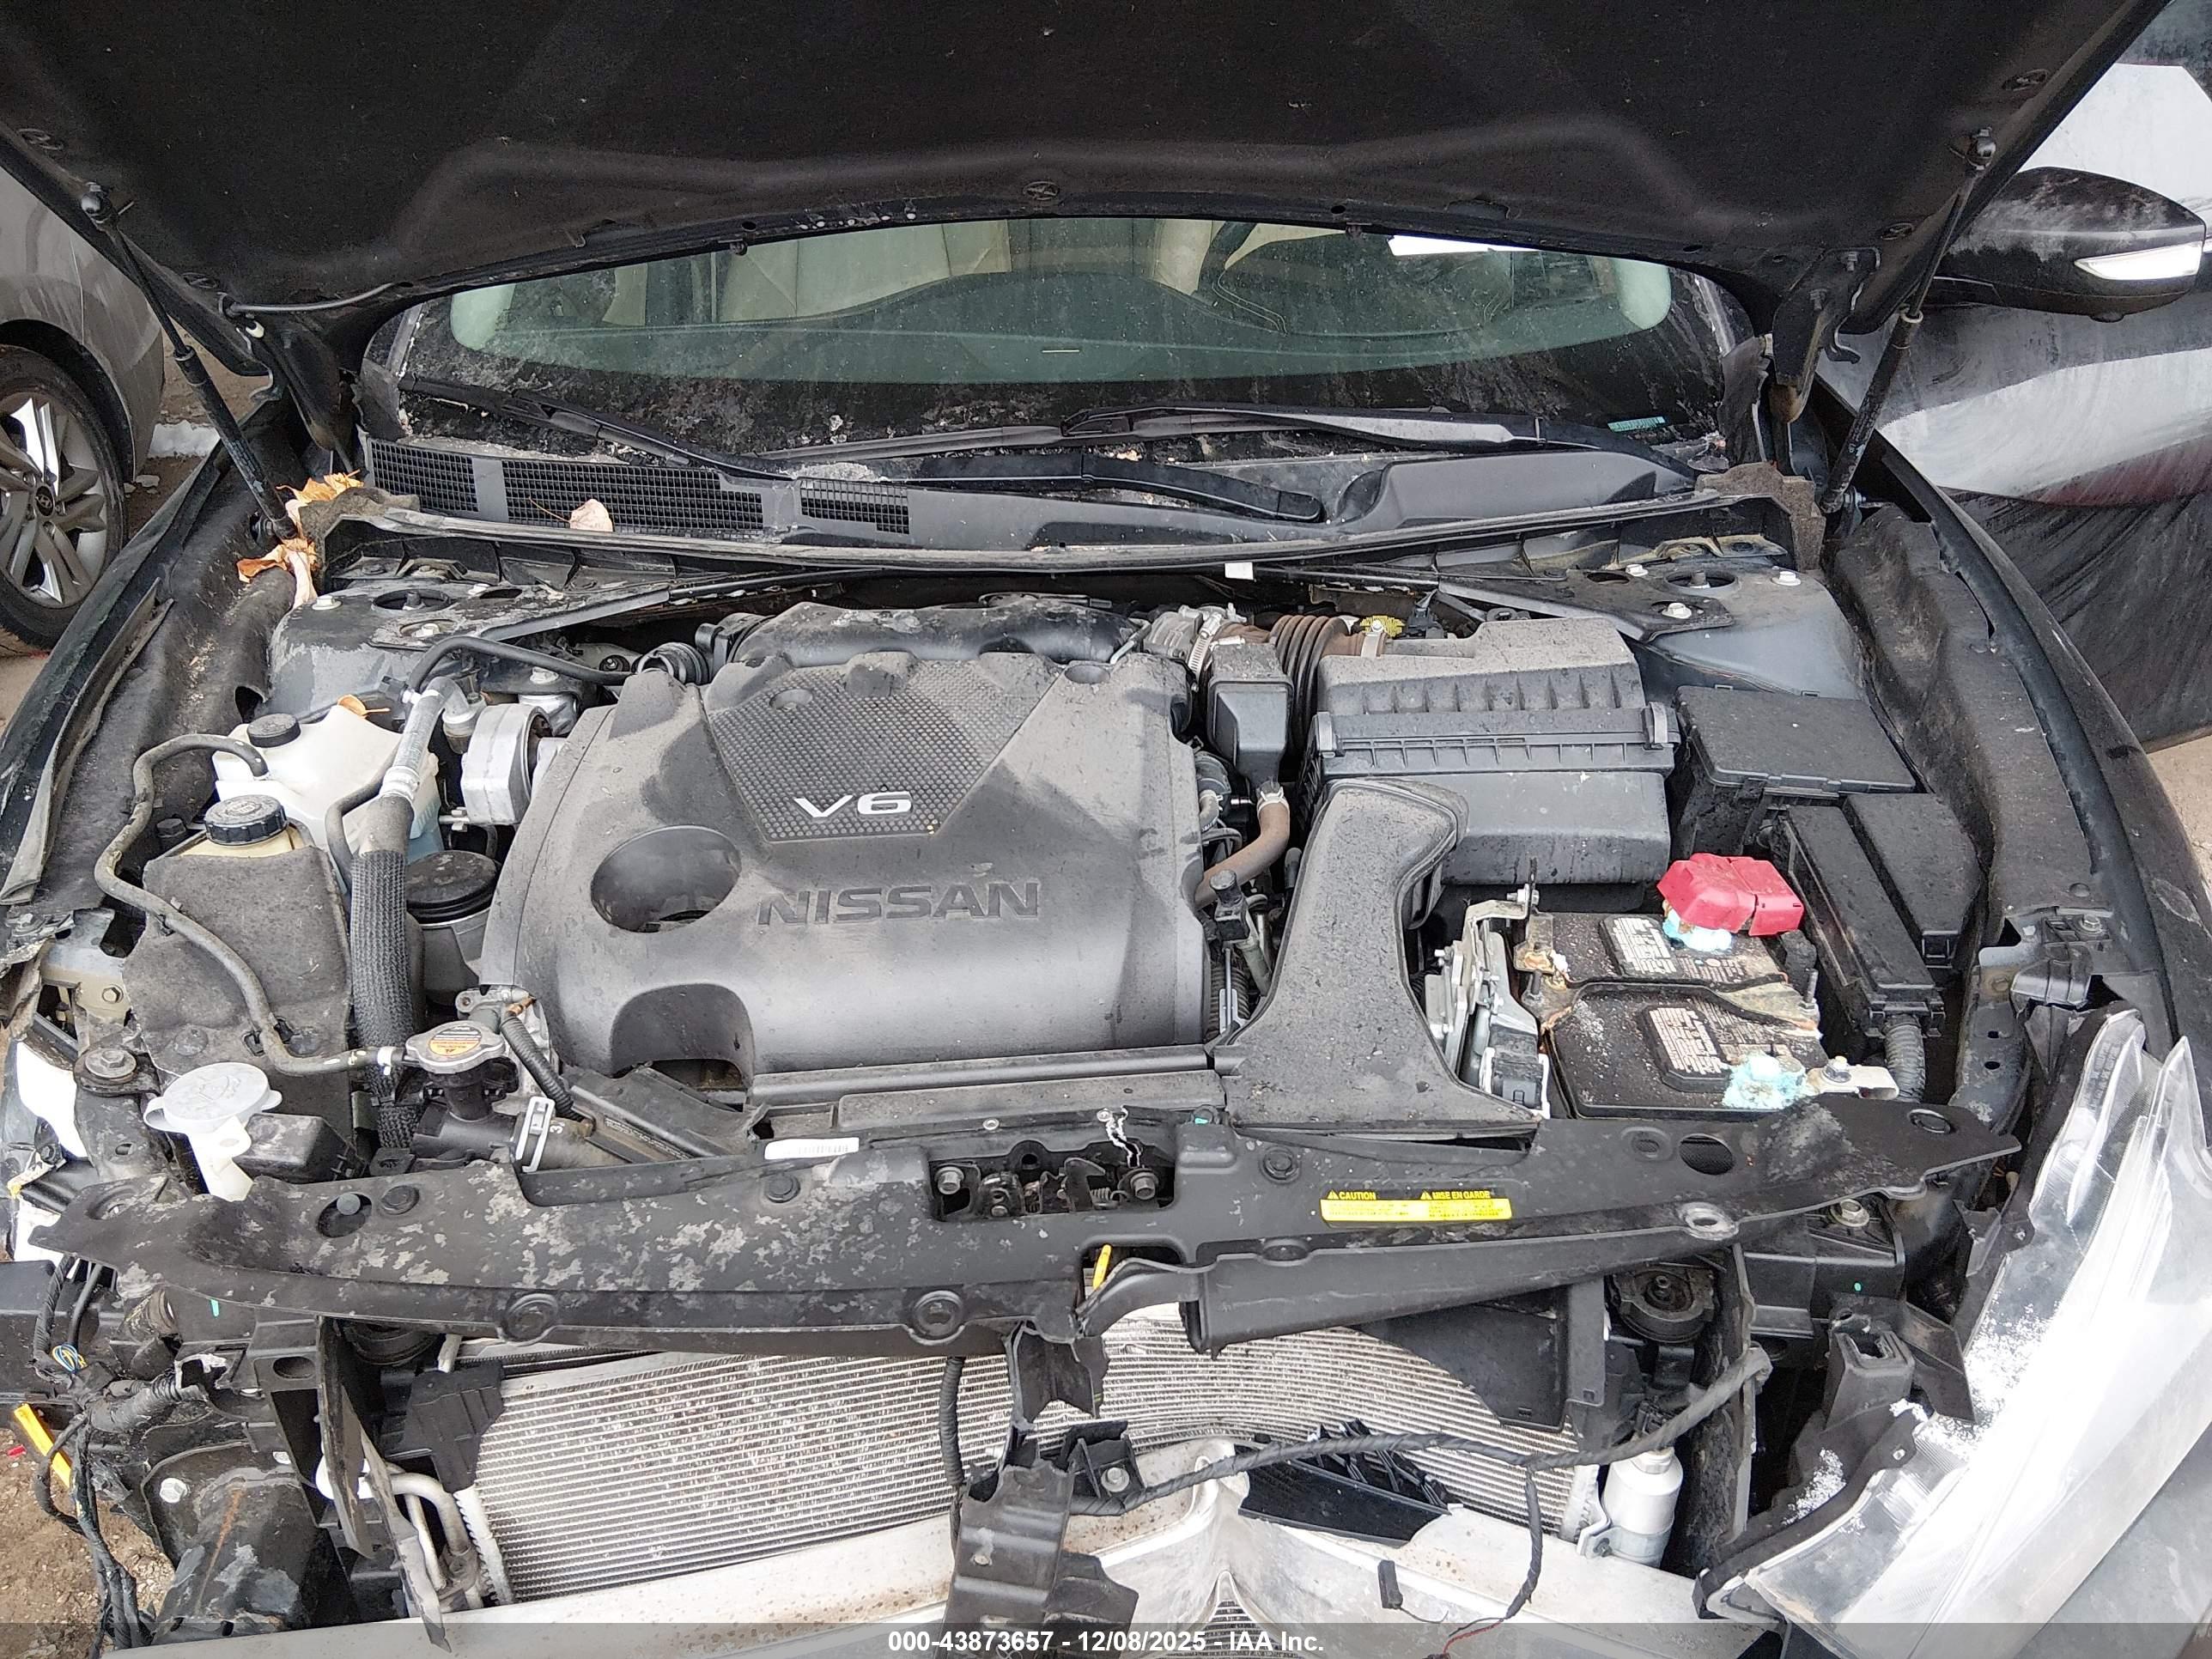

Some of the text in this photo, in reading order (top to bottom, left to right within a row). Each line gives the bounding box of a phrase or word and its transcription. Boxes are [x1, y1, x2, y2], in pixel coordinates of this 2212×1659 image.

[793, 790, 913, 818] V6
[757, 882, 1040, 926] NISSAN
[1339, 1191, 1376, 1200] CAUTION
[1431, 1190, 1492, 1200] MISE EN GARDE
